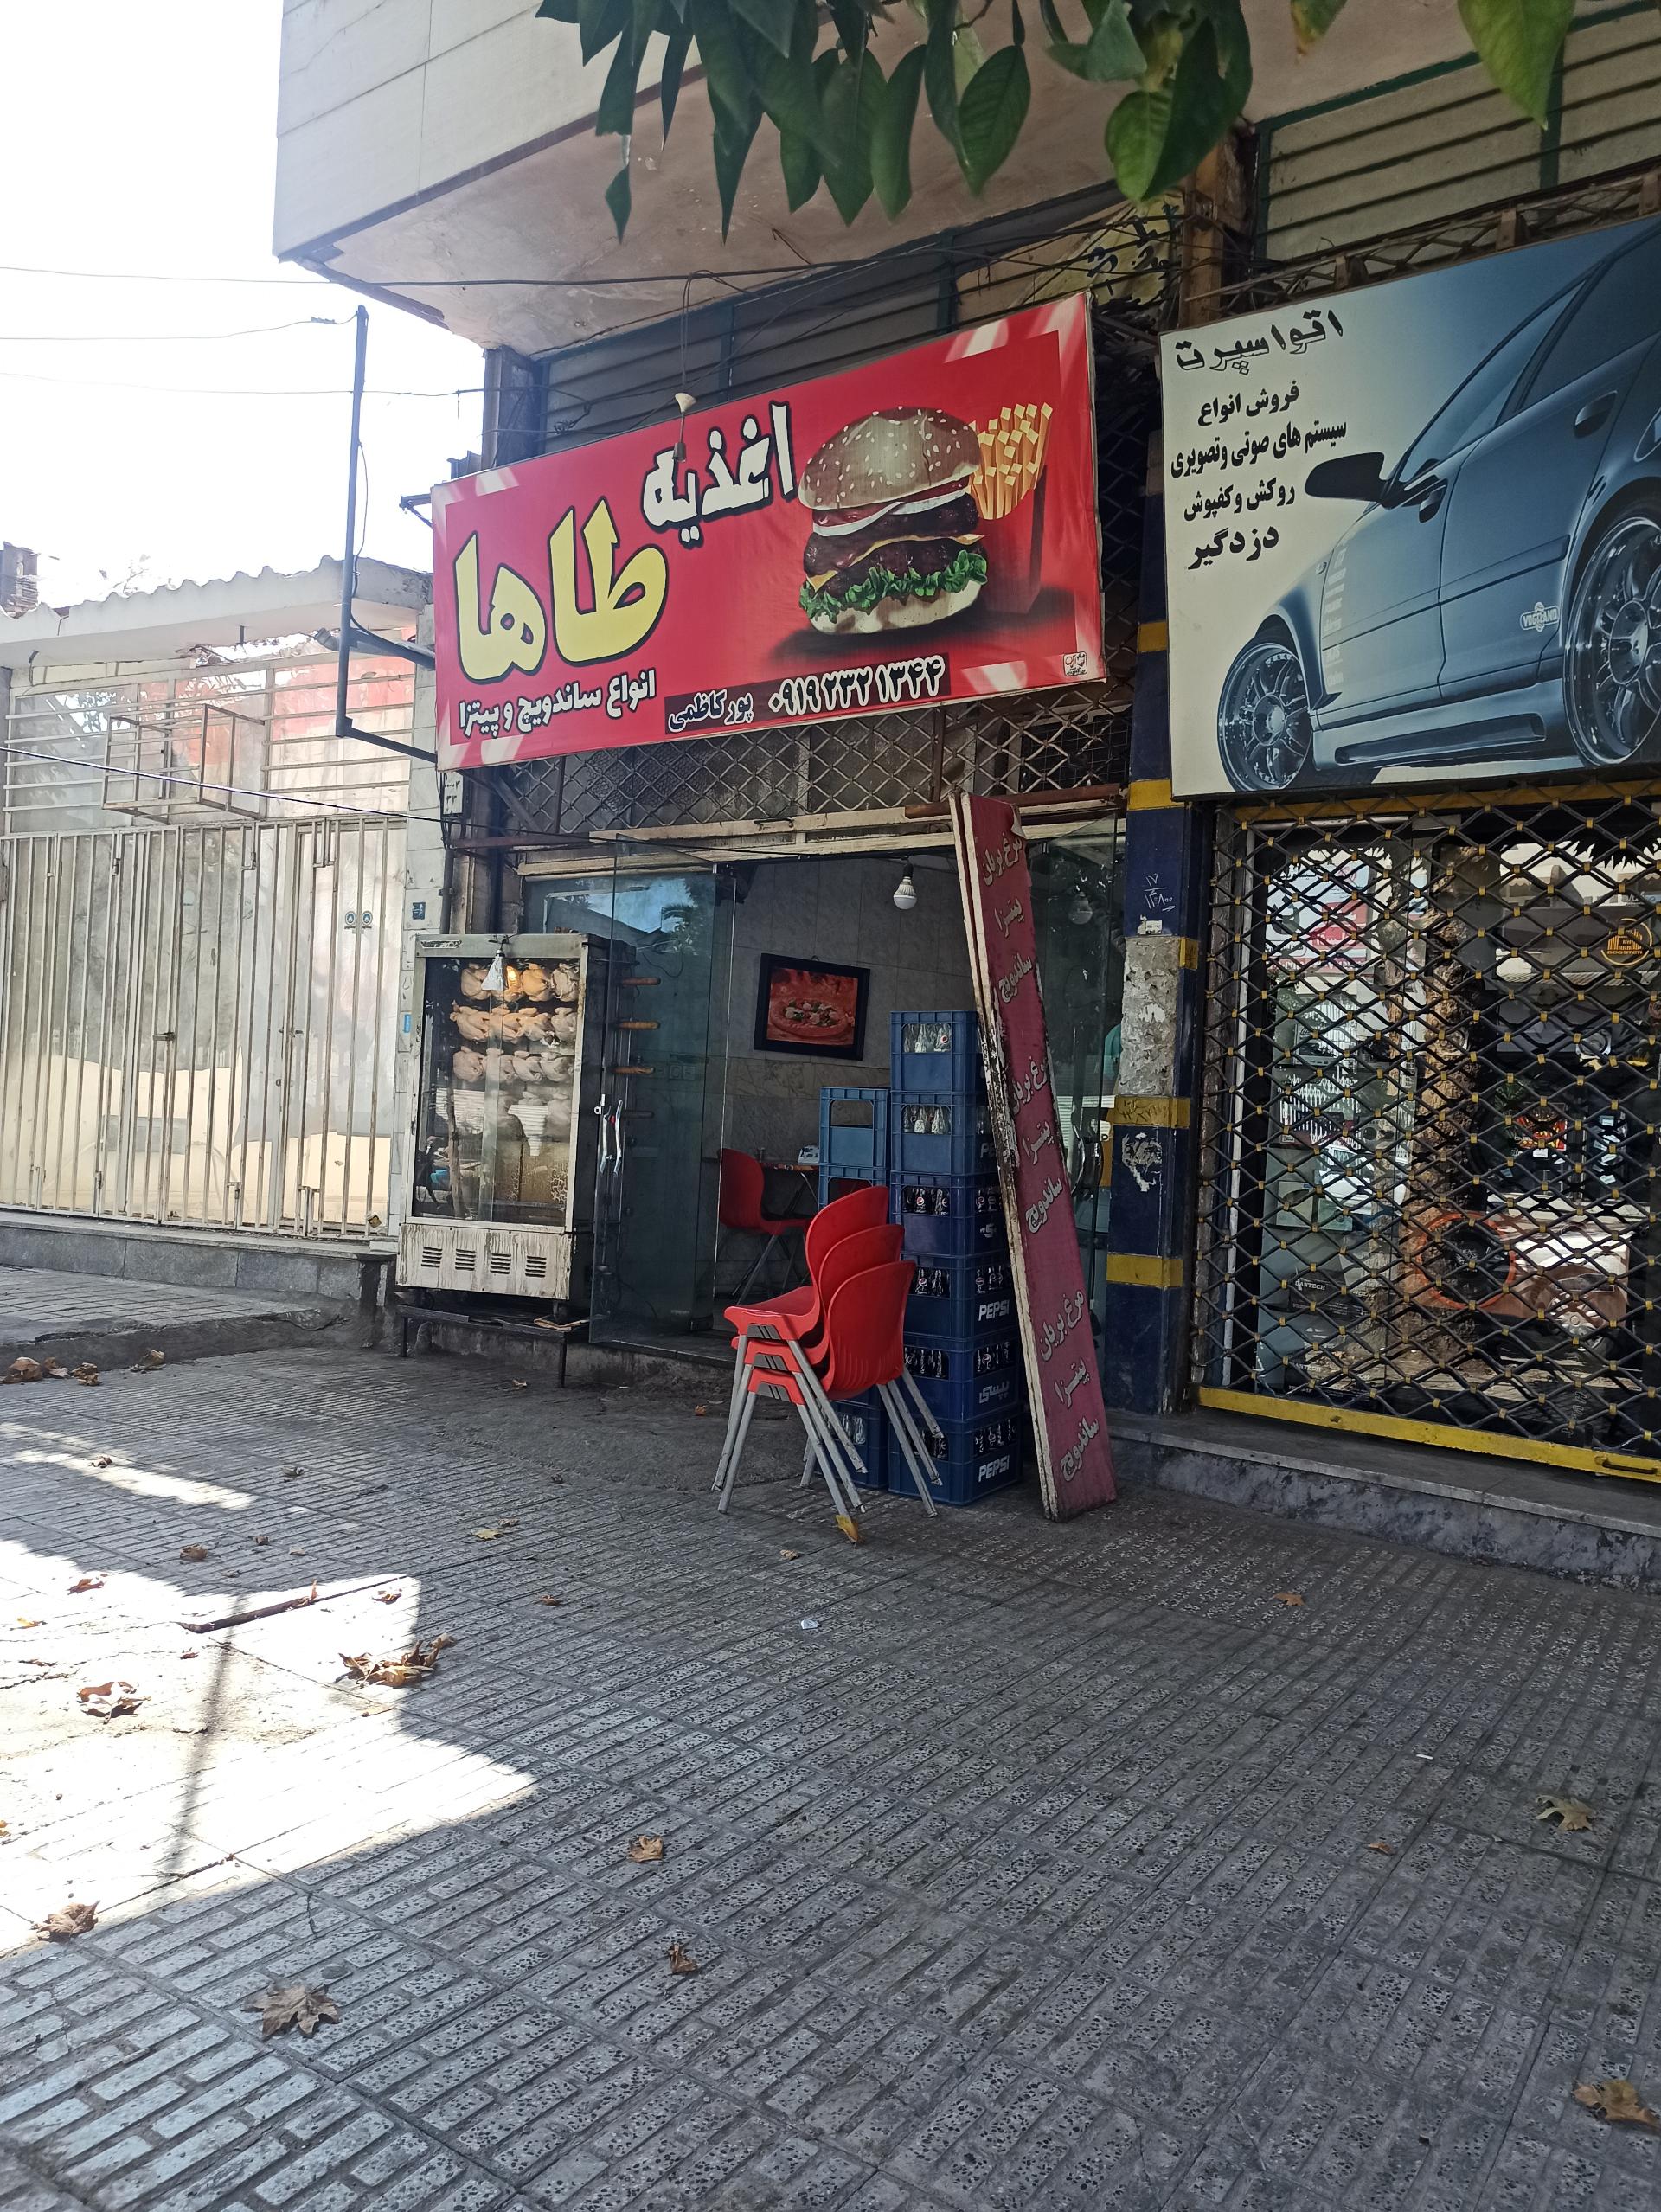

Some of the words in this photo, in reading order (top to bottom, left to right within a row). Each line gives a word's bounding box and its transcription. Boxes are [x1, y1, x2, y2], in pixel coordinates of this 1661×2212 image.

[1197, 393, 1241, 426] انواع
[1246, 380, 1299, 416] فروش
[1231, 431, 1269, 466] صوتی
[1273, 421, 1300, 458] های
[1305, 420, 1346, 453] سیستم
[642, 401, 794, 546] اغذیه
[1247, 478, 1295, 510] روکش
[1188, 526, 1279, 570] دزدگیر
[454, 497, 669, 681] طاها
[517, 681, 602, 732] ساندویچ
[606, 668, 657, 719] انواع
[459, 702, 499, 737] پیتزا
[503, 702, 514, 730] و
[1002, 832, 1023, 867] مرغ
[995, 899, 1024, 938] پیتزا
[998, 953, 1032, 1003] ساندویچ
[1022, 1121, 1054, 1164] پیتزا
[1025, 1176, 1063, 1234] ساندویچ
[978, 1299, 1010, 1321] PEPSI
[1062, 1290, 1084, 1329] مرغ
[1041, 1313, 1068, 1362] بریان
[1055, 1358, 1090, 1408] پیتزا
[978, 1455, 1010, 1482] PEPSI
[1060, 1416, 1100, 1482] ساندویچ
